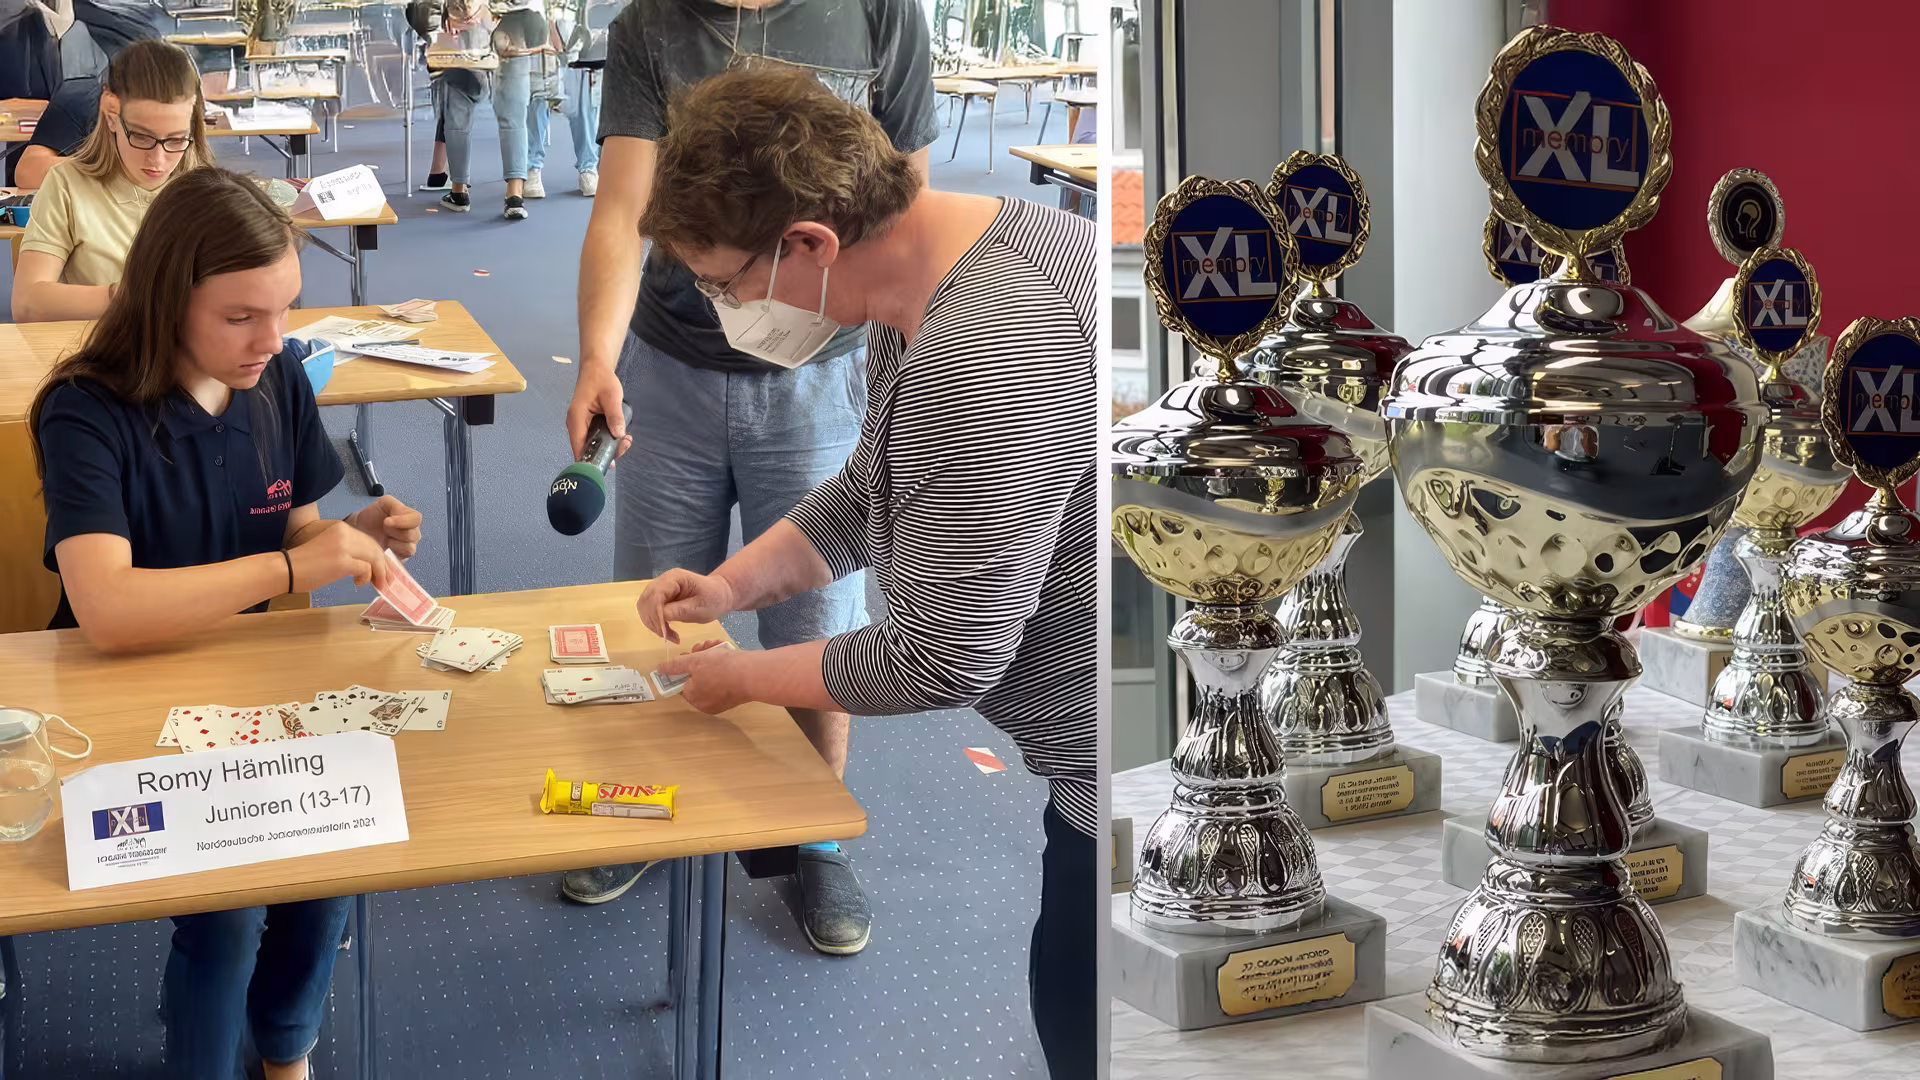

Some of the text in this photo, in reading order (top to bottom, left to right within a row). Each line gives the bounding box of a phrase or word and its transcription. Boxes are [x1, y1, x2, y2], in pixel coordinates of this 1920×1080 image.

[1518, 91, 1640, 187] XL
[1523, 128, 1629, 162] memory
[1288, 186, 1352, 244] XL
[1180, 226, 1278, 299] XL
[1182, 257, 1266, 277] memory
[1752, 278, 1808, 327] XL
[1855, 393, 1920, 415] memo
[137, 754, 325, 795] Romy Hämling
[110, 806, 150, 837] XL
[205, 785, 371, 824] Junioren (13-17)
